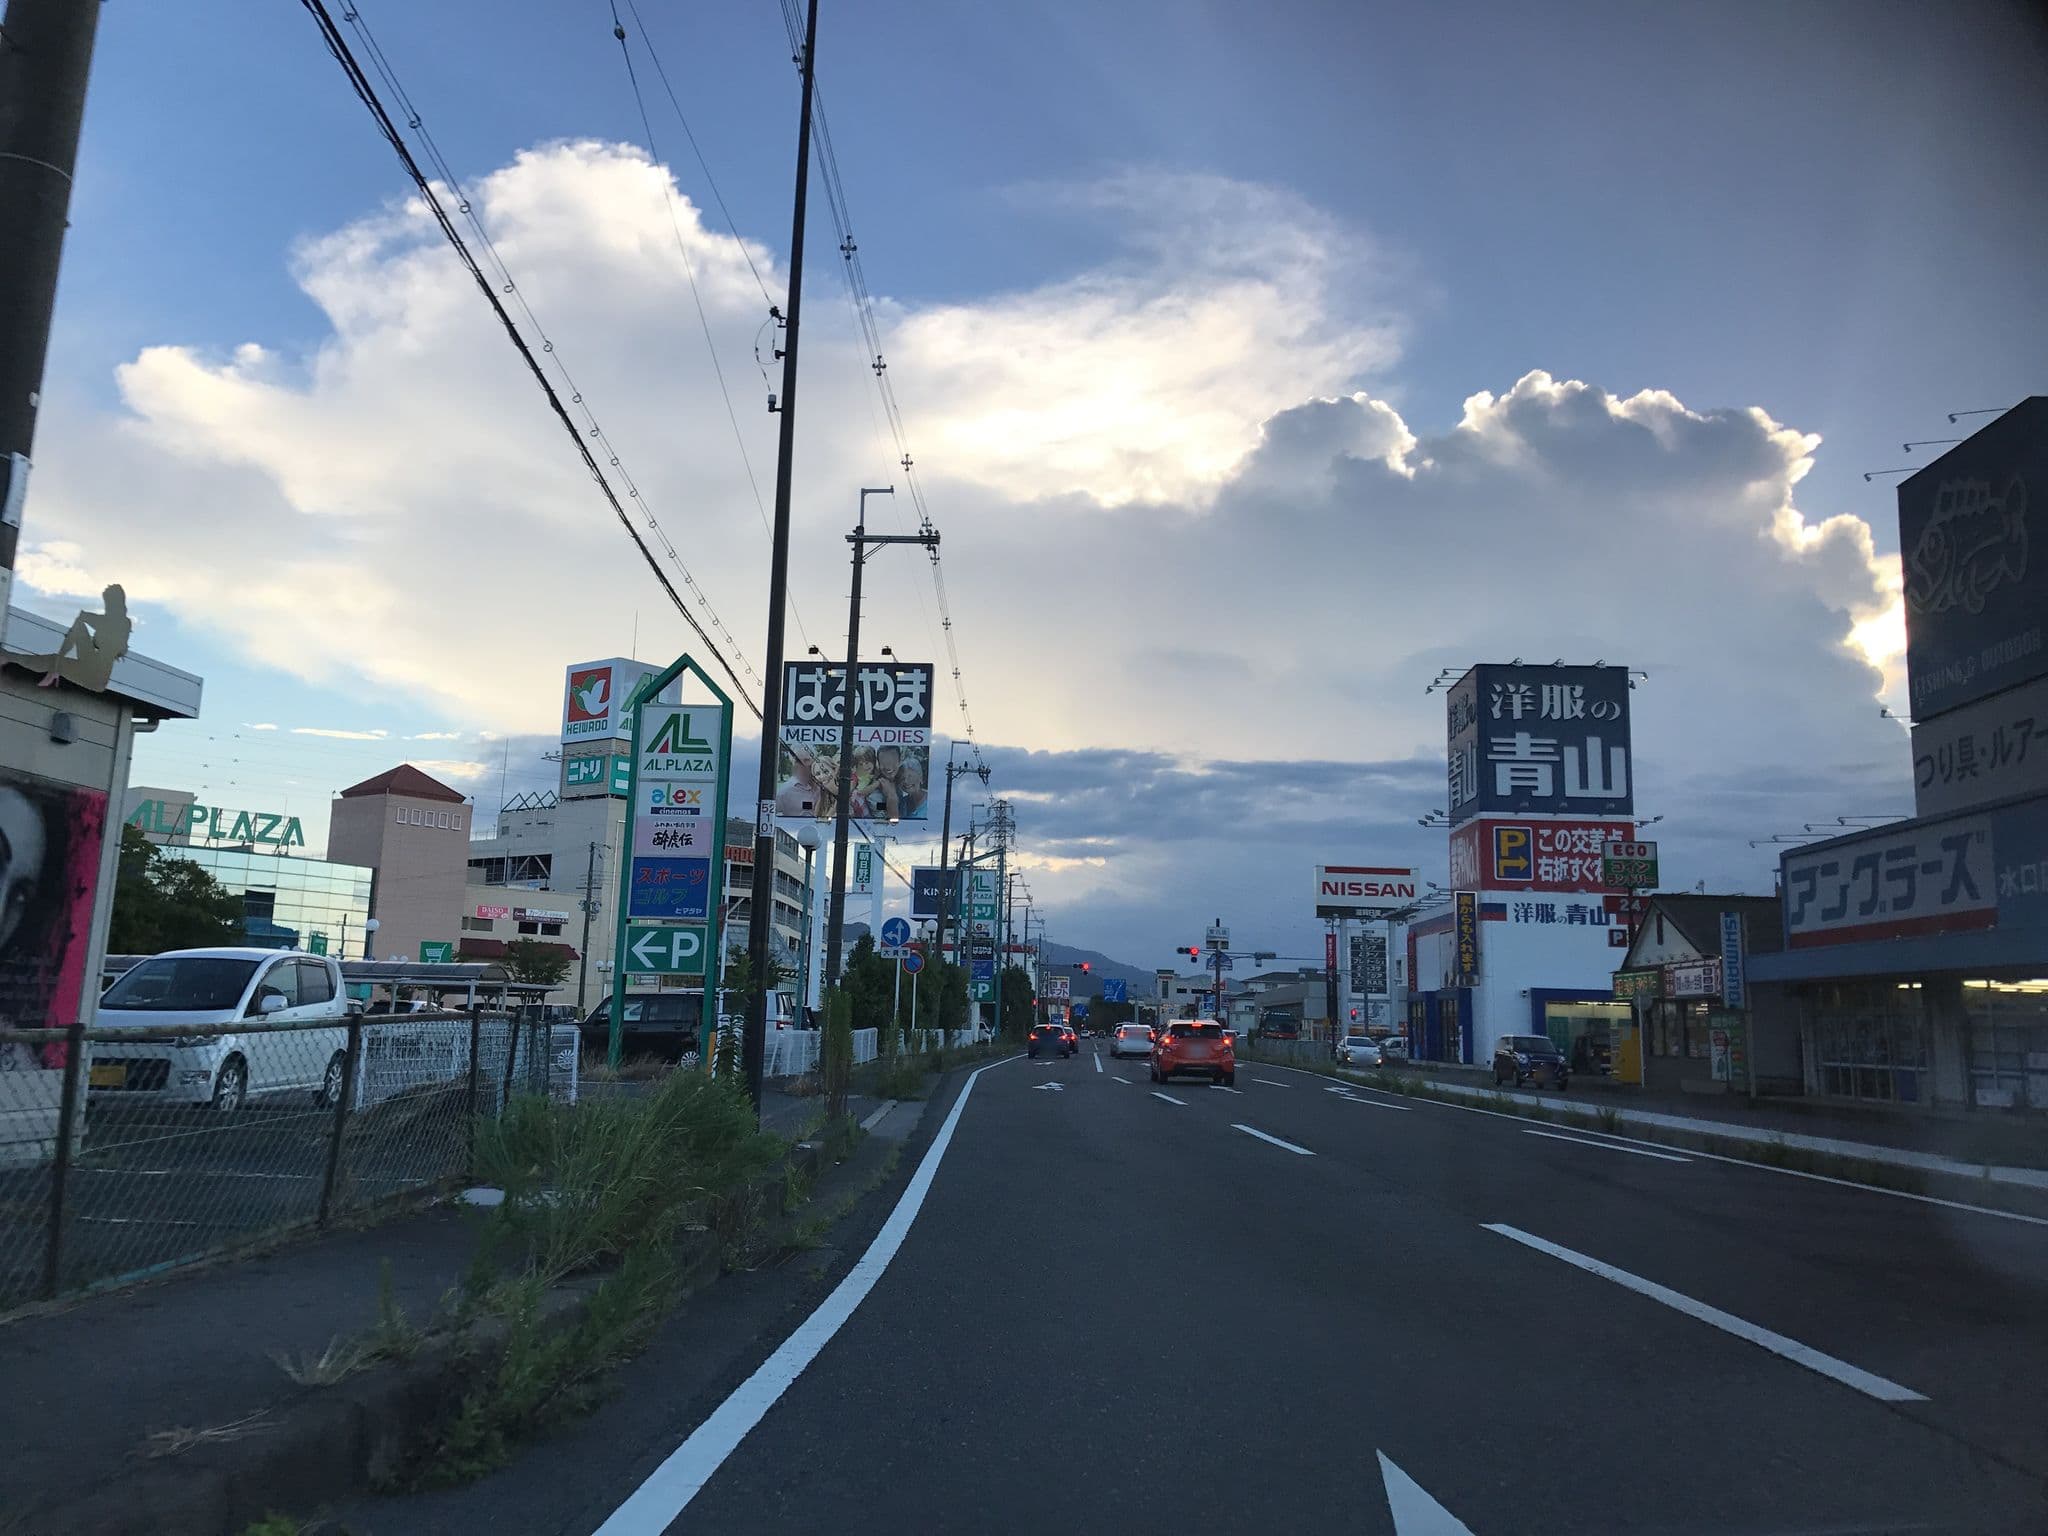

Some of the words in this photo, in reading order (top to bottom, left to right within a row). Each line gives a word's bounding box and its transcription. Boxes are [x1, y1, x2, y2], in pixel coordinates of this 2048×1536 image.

[786, 666, 927, 723] はるやま
[1490, 683, 1621, 721] 洋服の
[566, 719, 608, 735] HEIWADO
[785, 728, 837, 742] MENS
[858, 729, 924, 744] LADIES
[567, 759, 601, 782] ニトリ
[643, 758, 713, 772] AL.PLAZA
[1487, 732, 1627, 798] 青山
[652, 783, 700, 806] alex
[761, 803, 775, 813] 52
[766, 814, 771, 822] 1
[761, 822, 773, 832] 01
[1501, 830, 1526, 856] P
[1613, 844, 1647, 856] ECO
[637, 867, 705, 885] スポーツ
[1789, 832, 1986, 925] アングラーズ
[1321, 881, 1415, 897] NISSAN
[481, 906, 504, 914] DAISO
[1514, 902, 1611, 926] 洋服の青山
[1613, 930, 1623, 945] P
[670, 931, 700, 969] P
[977, 983, 989, 998] P
